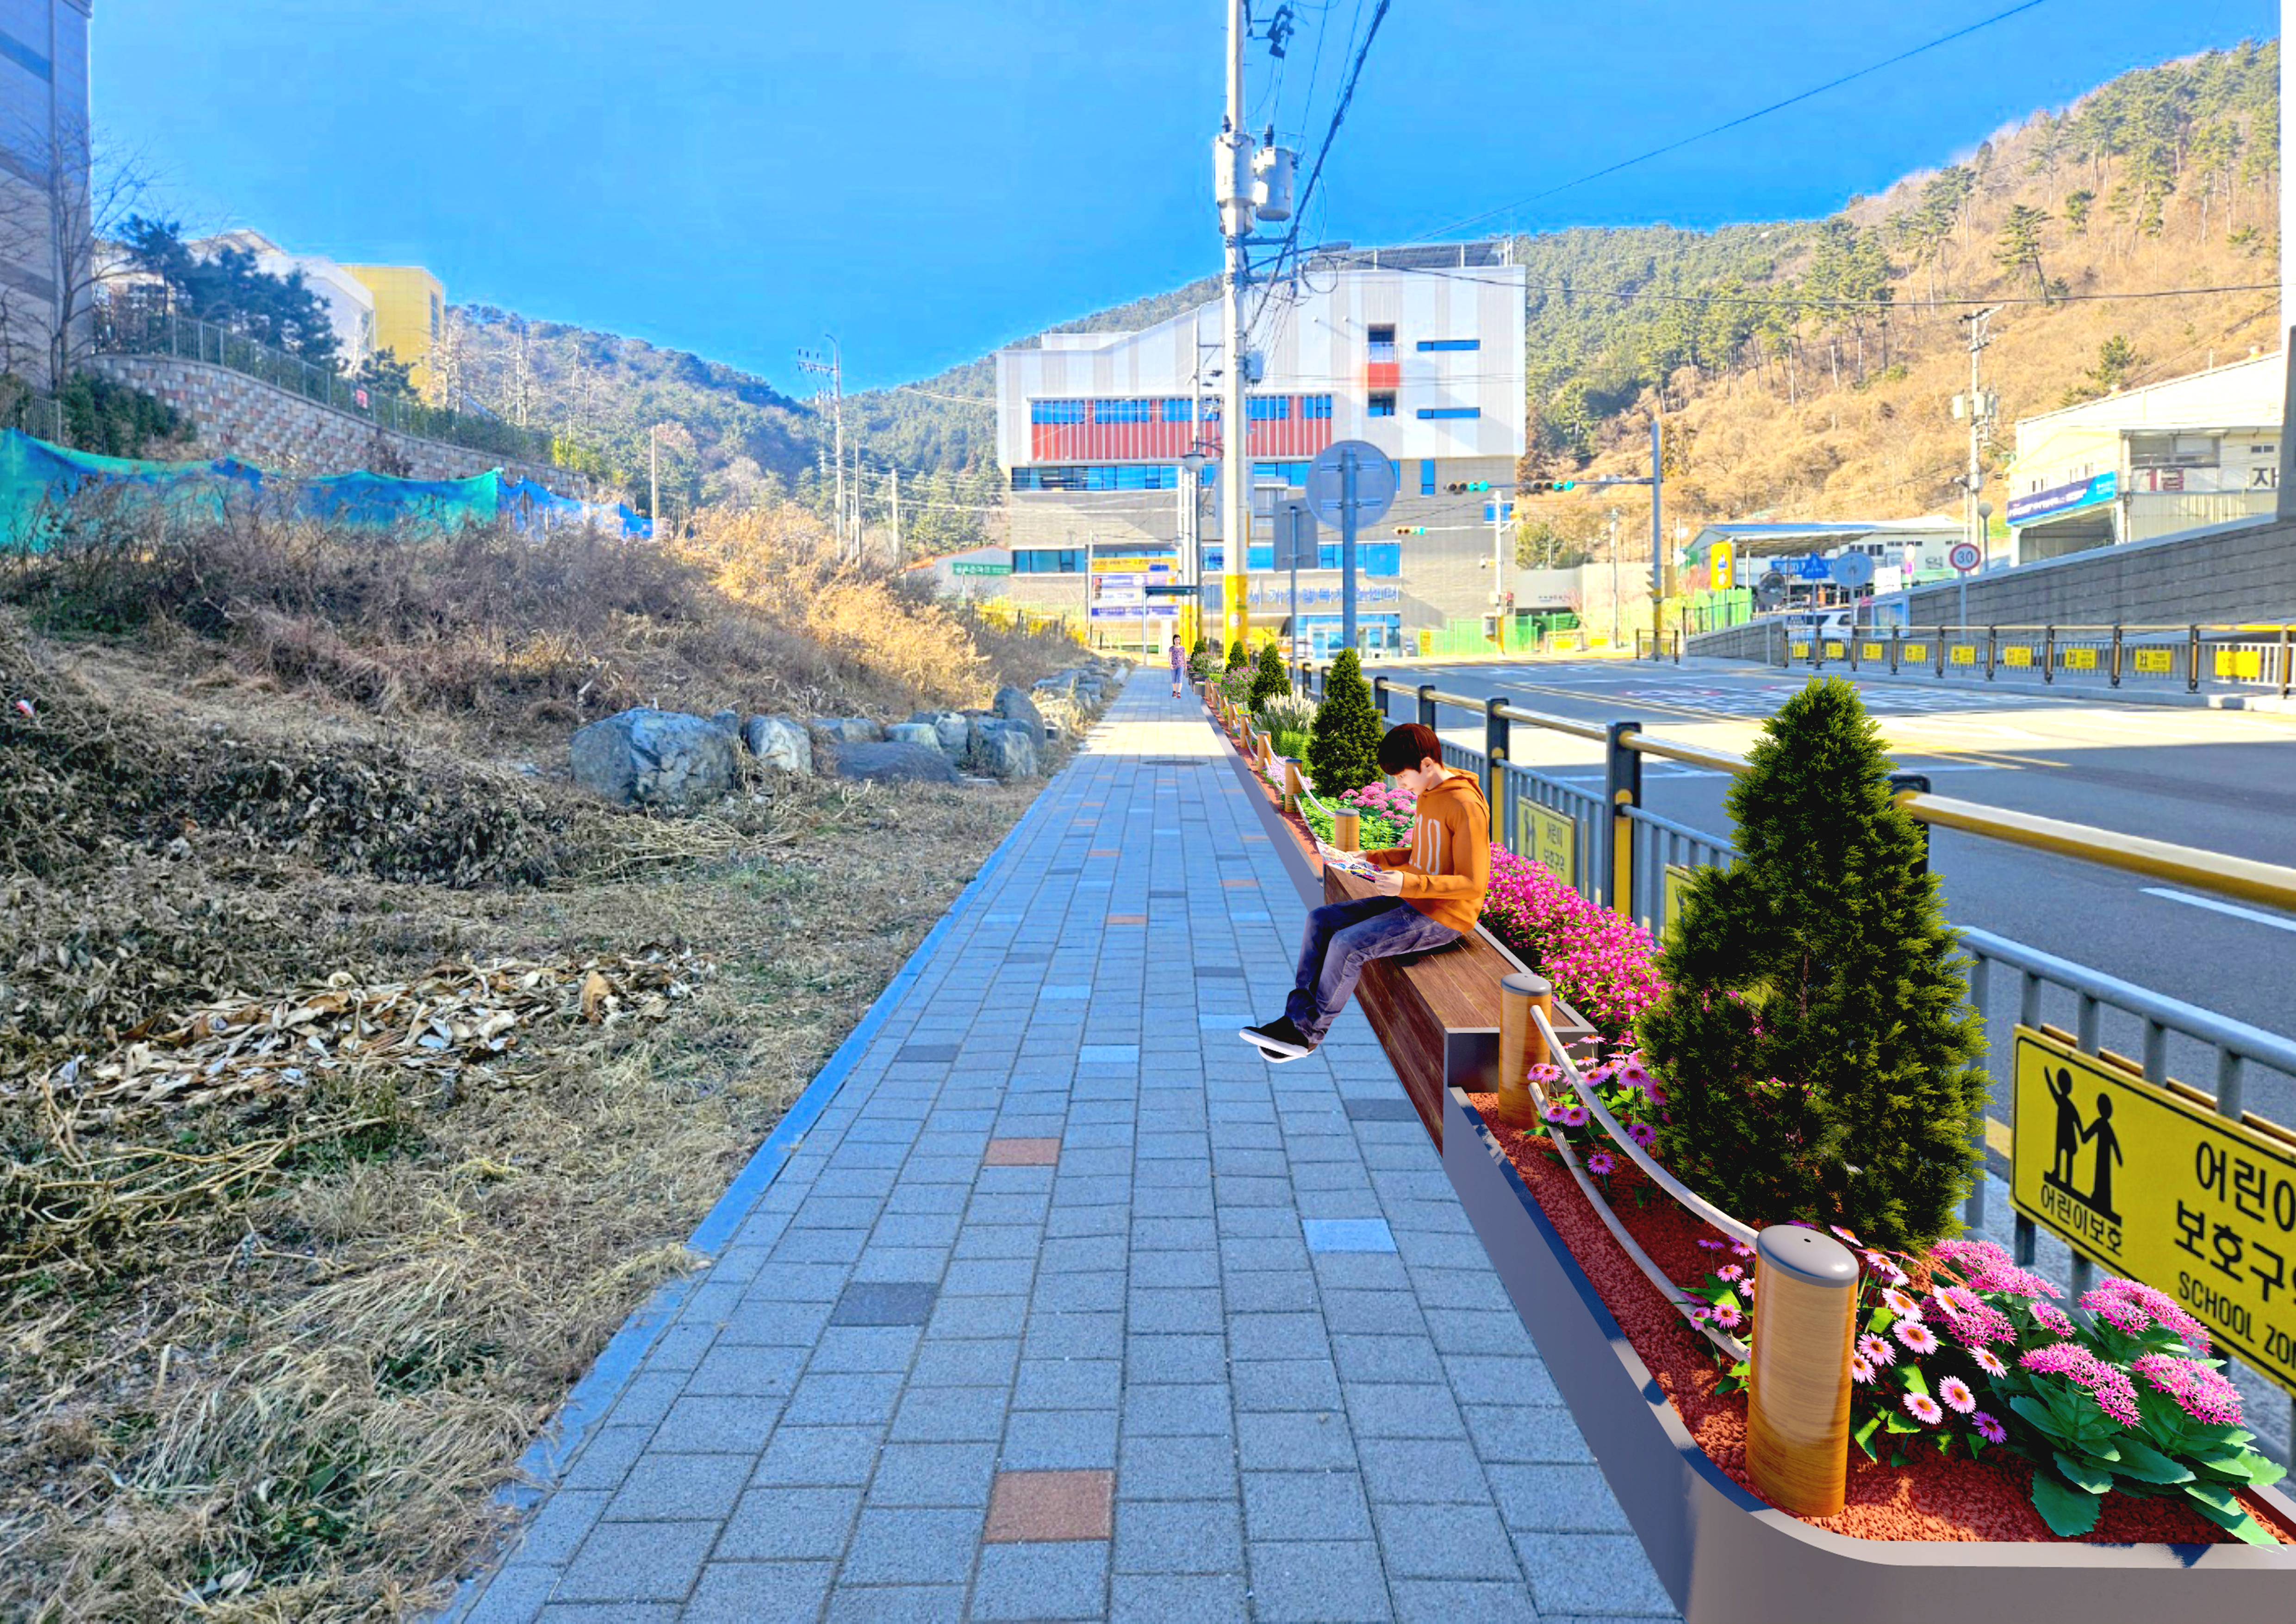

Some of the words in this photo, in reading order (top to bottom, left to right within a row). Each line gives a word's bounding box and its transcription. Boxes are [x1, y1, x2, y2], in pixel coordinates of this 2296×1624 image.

[1957, 550, 1973, 563] 30
[2041, 1184, 2122, 1258] 어린이보호
[2174, 1199, 2296, 1302] 보호구
[2179, 1271, 2255, 1343] SCHOOL
